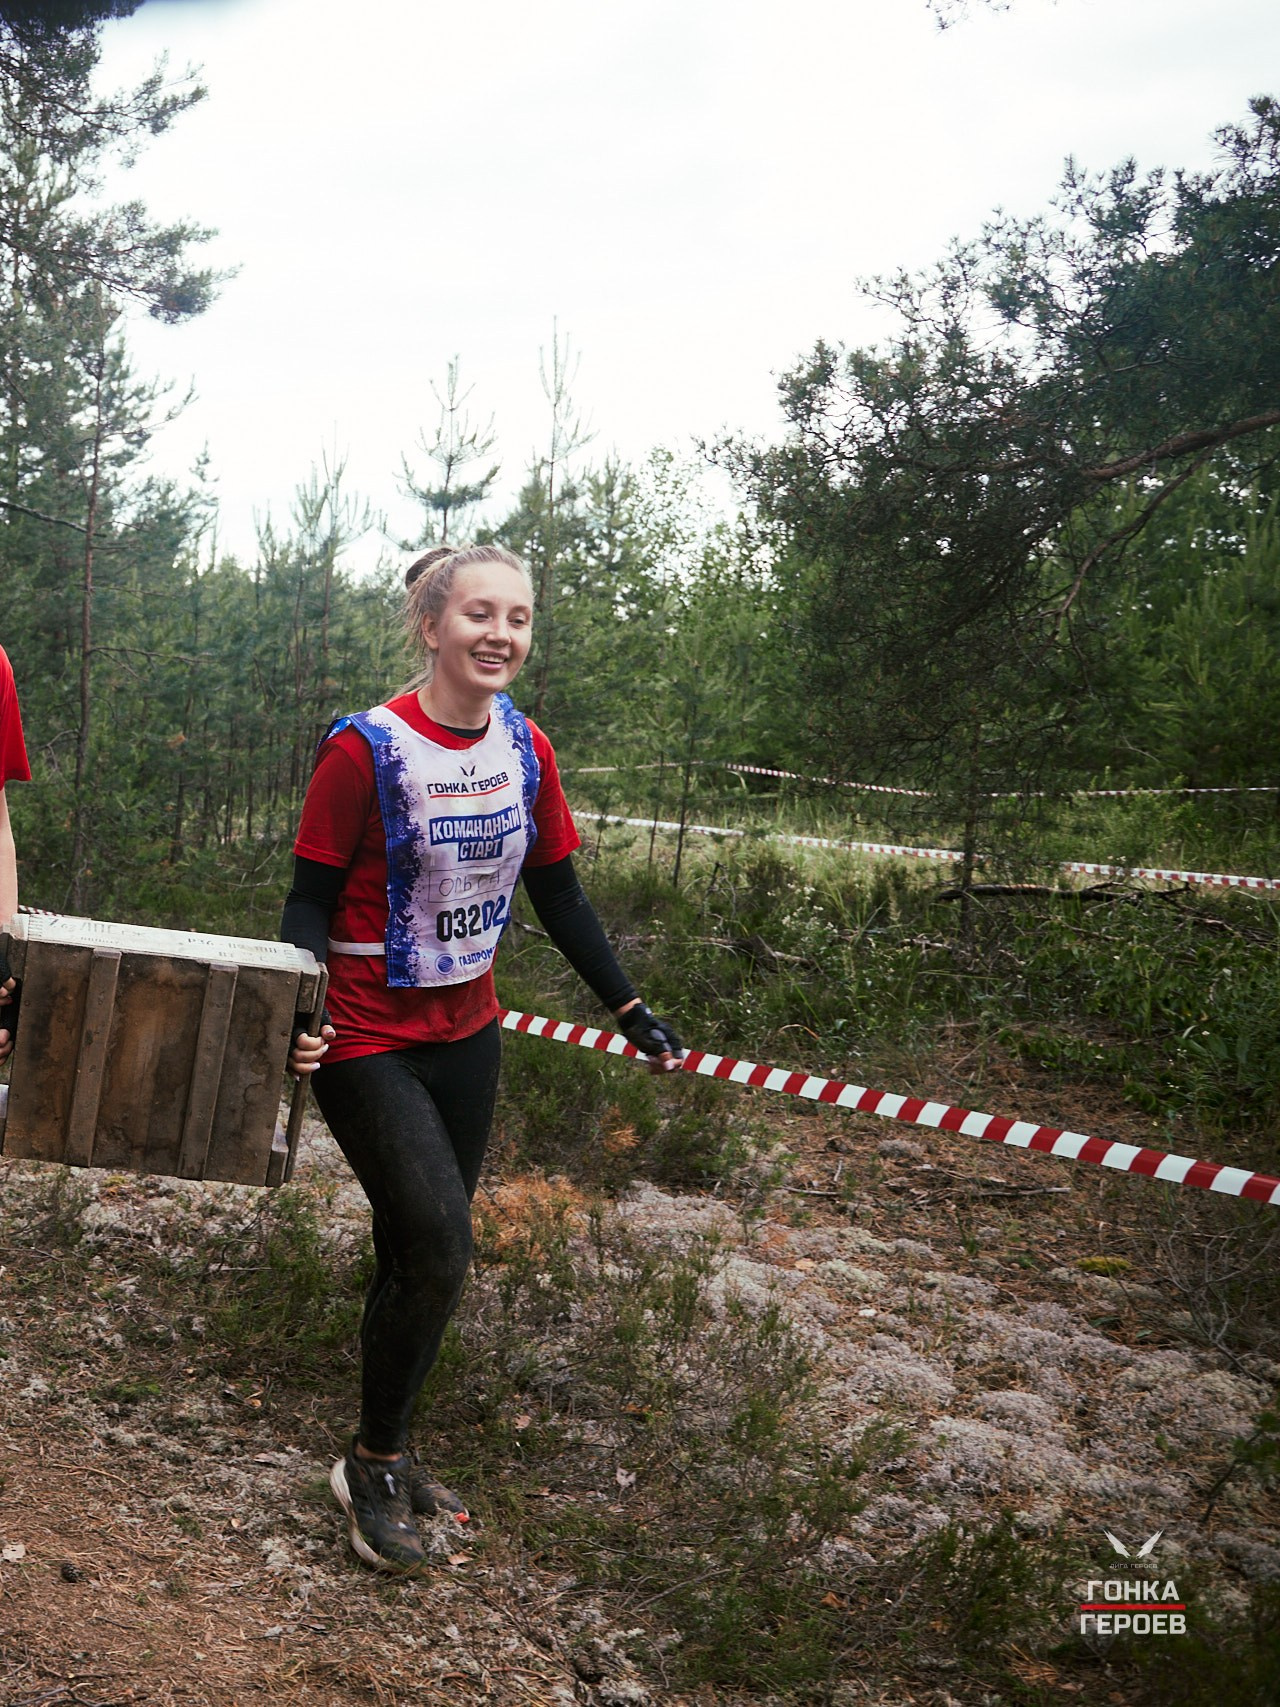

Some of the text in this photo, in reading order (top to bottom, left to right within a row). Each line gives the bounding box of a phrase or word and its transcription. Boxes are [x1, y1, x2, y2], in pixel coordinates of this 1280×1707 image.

[427, 771, 509, 795] ГОНКА ГЕРОЕВ
[431, 804, 520, 841] КОМАНДНЫЙ
[460, 839, 501, 859] СТАРТ
[438, 869, 500, 897] ОЛЬГА
[436, 894, 507, 942] 03202
[458, 946, 495, 967] ГАЗПРОМ
